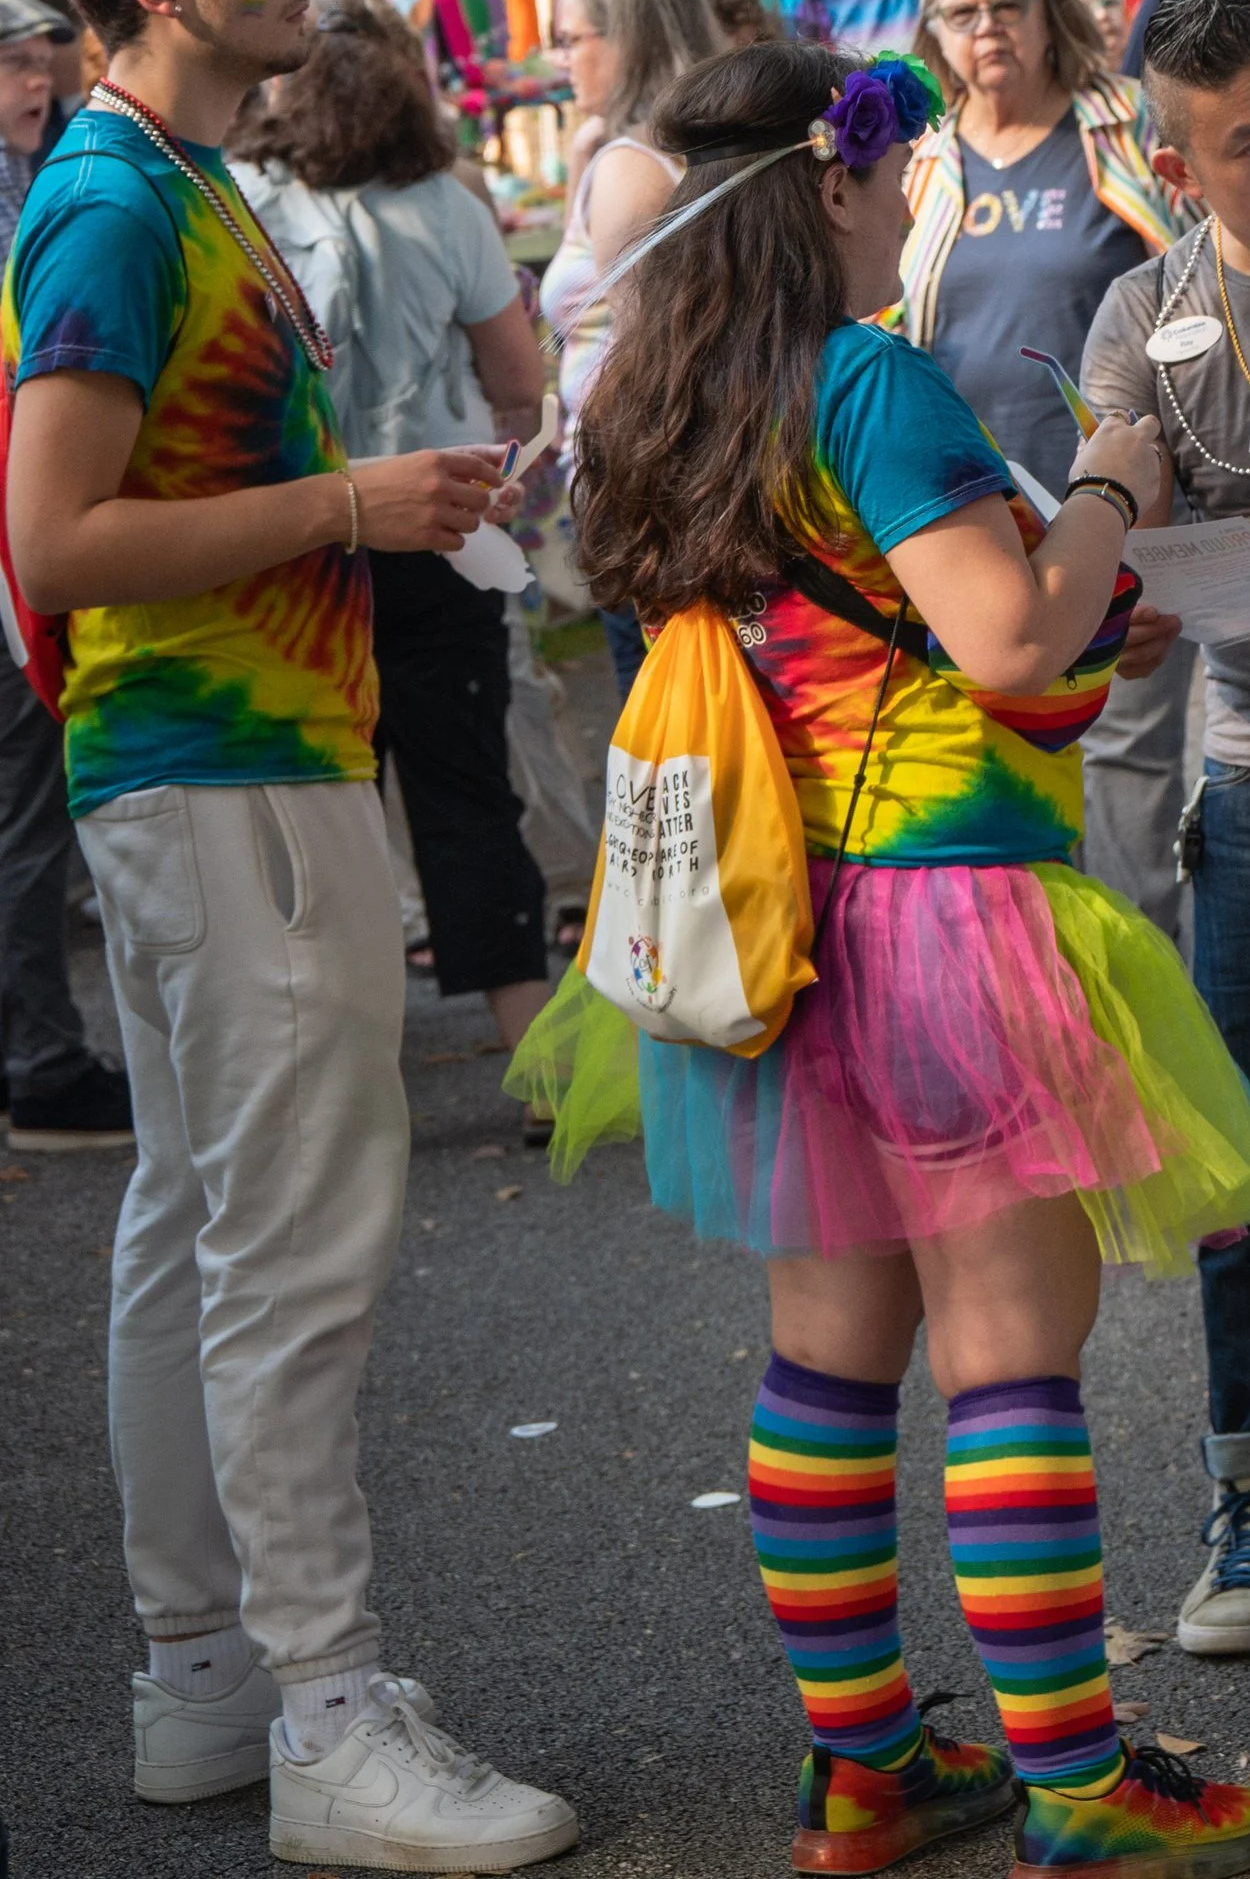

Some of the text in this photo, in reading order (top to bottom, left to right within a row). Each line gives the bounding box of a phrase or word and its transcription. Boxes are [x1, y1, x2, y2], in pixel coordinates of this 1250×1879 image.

[961, 188, 1067, 238] OVE
[609, 772, 657, 811] OVE
[661, 770, 690, 794] ACK
[661, 790, 691, 815] VES
[658, 812, 694, 840] ATTER
[679, 839, 699, 855] OF
